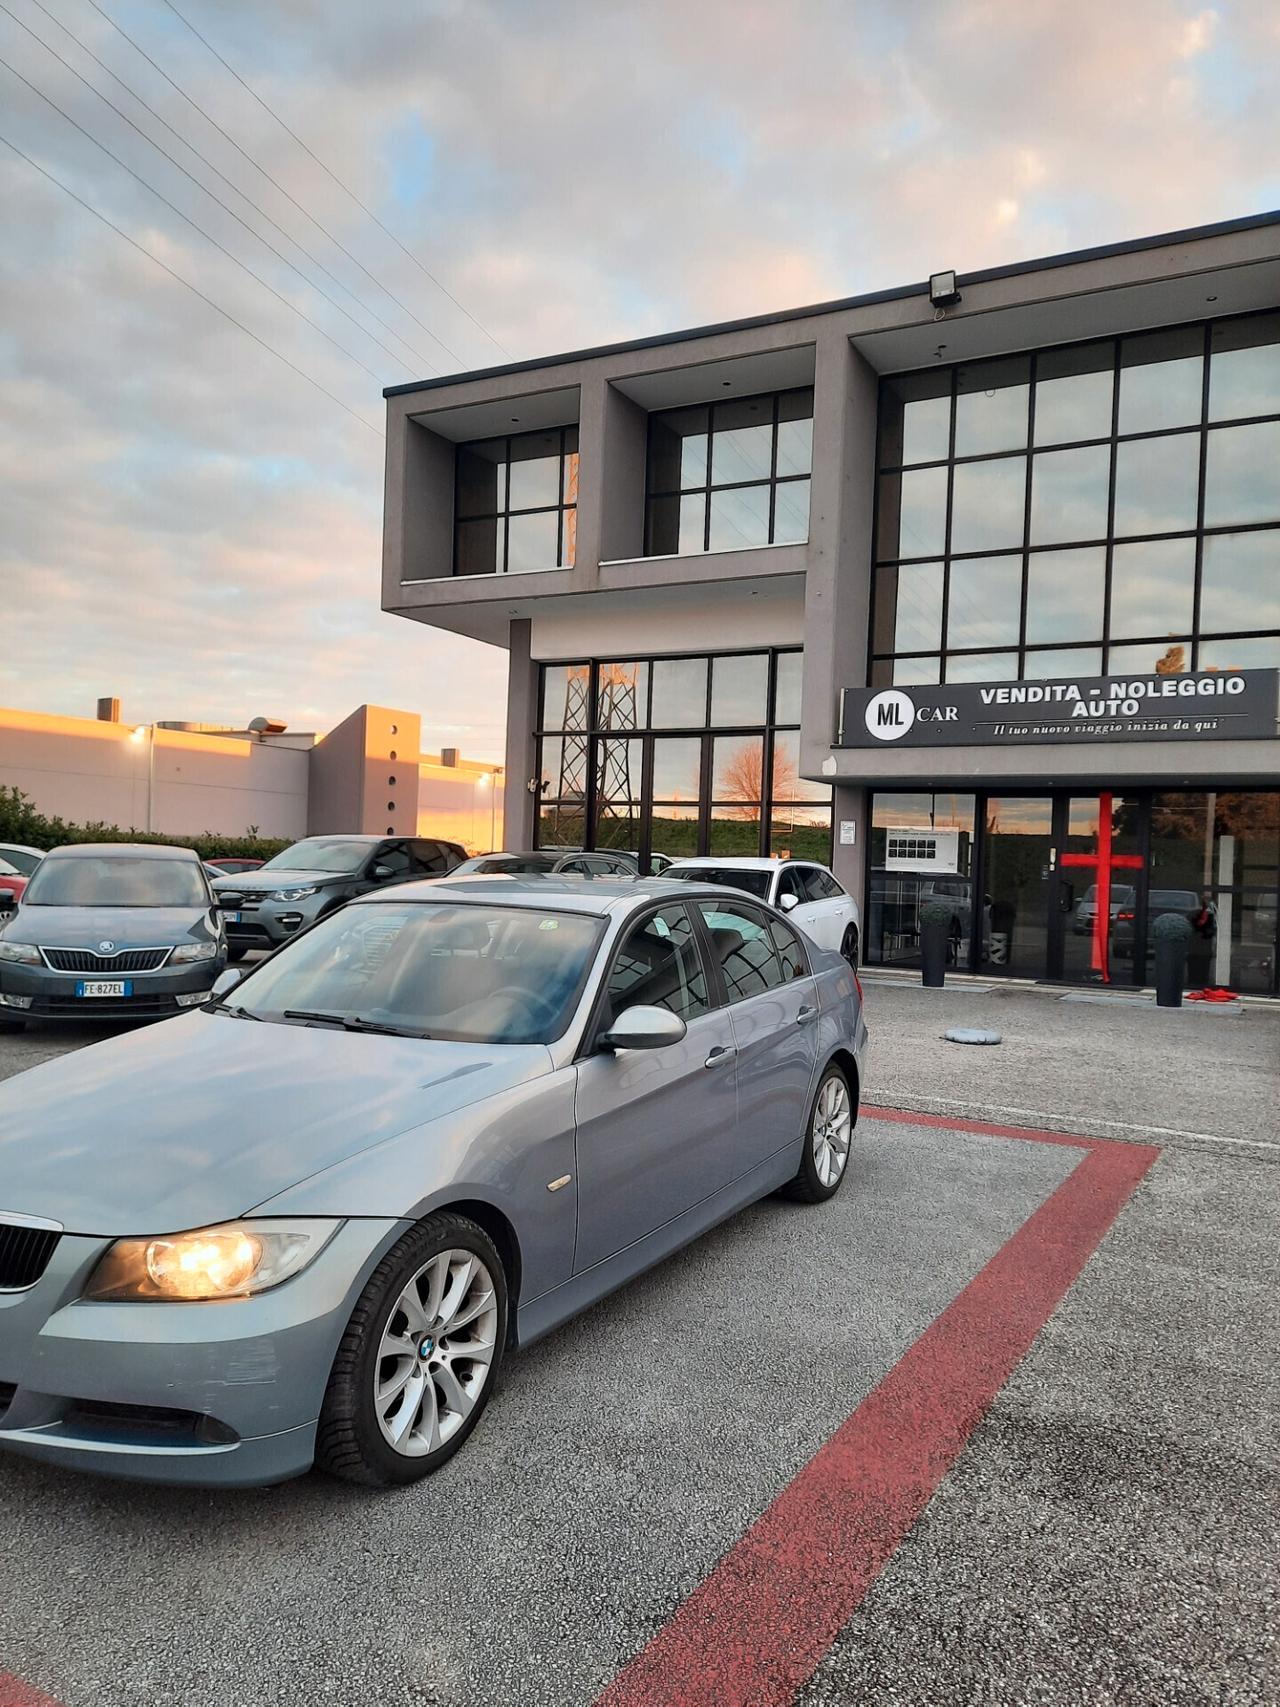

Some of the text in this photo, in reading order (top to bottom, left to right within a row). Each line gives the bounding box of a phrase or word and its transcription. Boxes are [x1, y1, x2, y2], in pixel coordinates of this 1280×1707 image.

[980, 685, 1082, 704] VENDITA
[1110, 677, 1246, 699] NOLEGGIO
[877, 703, 959, 726] ML CAR
[1071, 699, 1140, 717] AUTO
[993, 725, 1006, 735] Il
[1008, 726, 1029, 735] tuo
[1074, 721, 1123, 735] viaggio
[1127, 720, 1168, 731] inizia
[1173, 719, 1190, 730] da
[1195, 717, 1218, 732] qui
